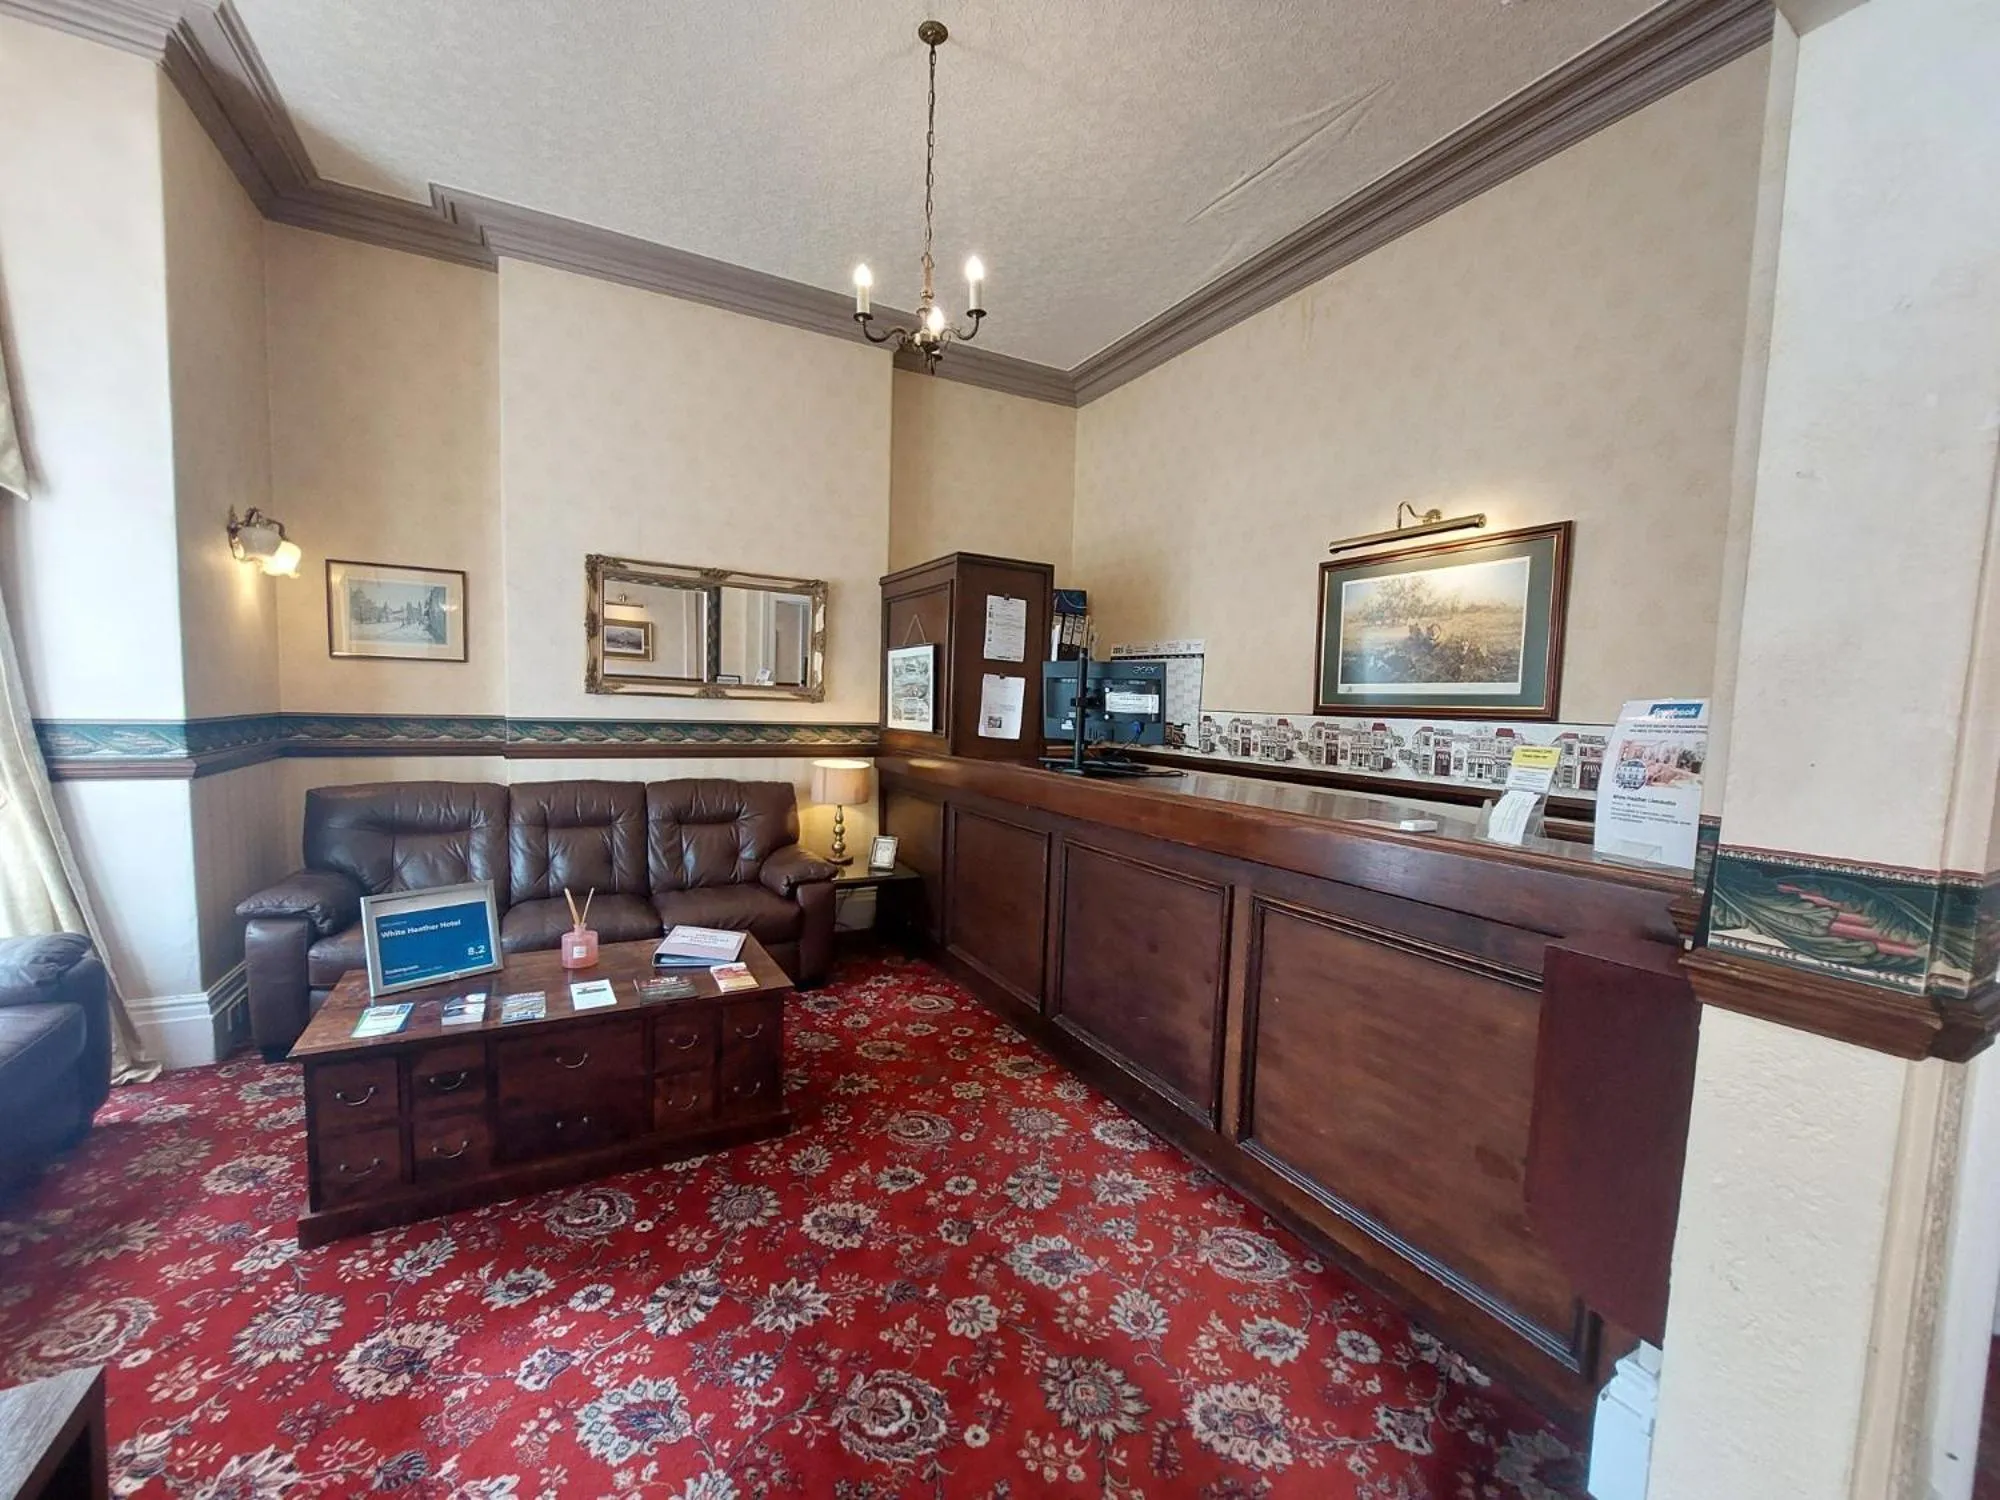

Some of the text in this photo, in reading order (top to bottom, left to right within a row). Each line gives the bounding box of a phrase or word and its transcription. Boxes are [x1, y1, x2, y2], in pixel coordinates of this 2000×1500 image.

[381, 928, 406, 939] White
[407, 924, 439, 935] Heather
[439, 919, 462, 929] Hotel
[467, 945, 486, 956] 8.2
